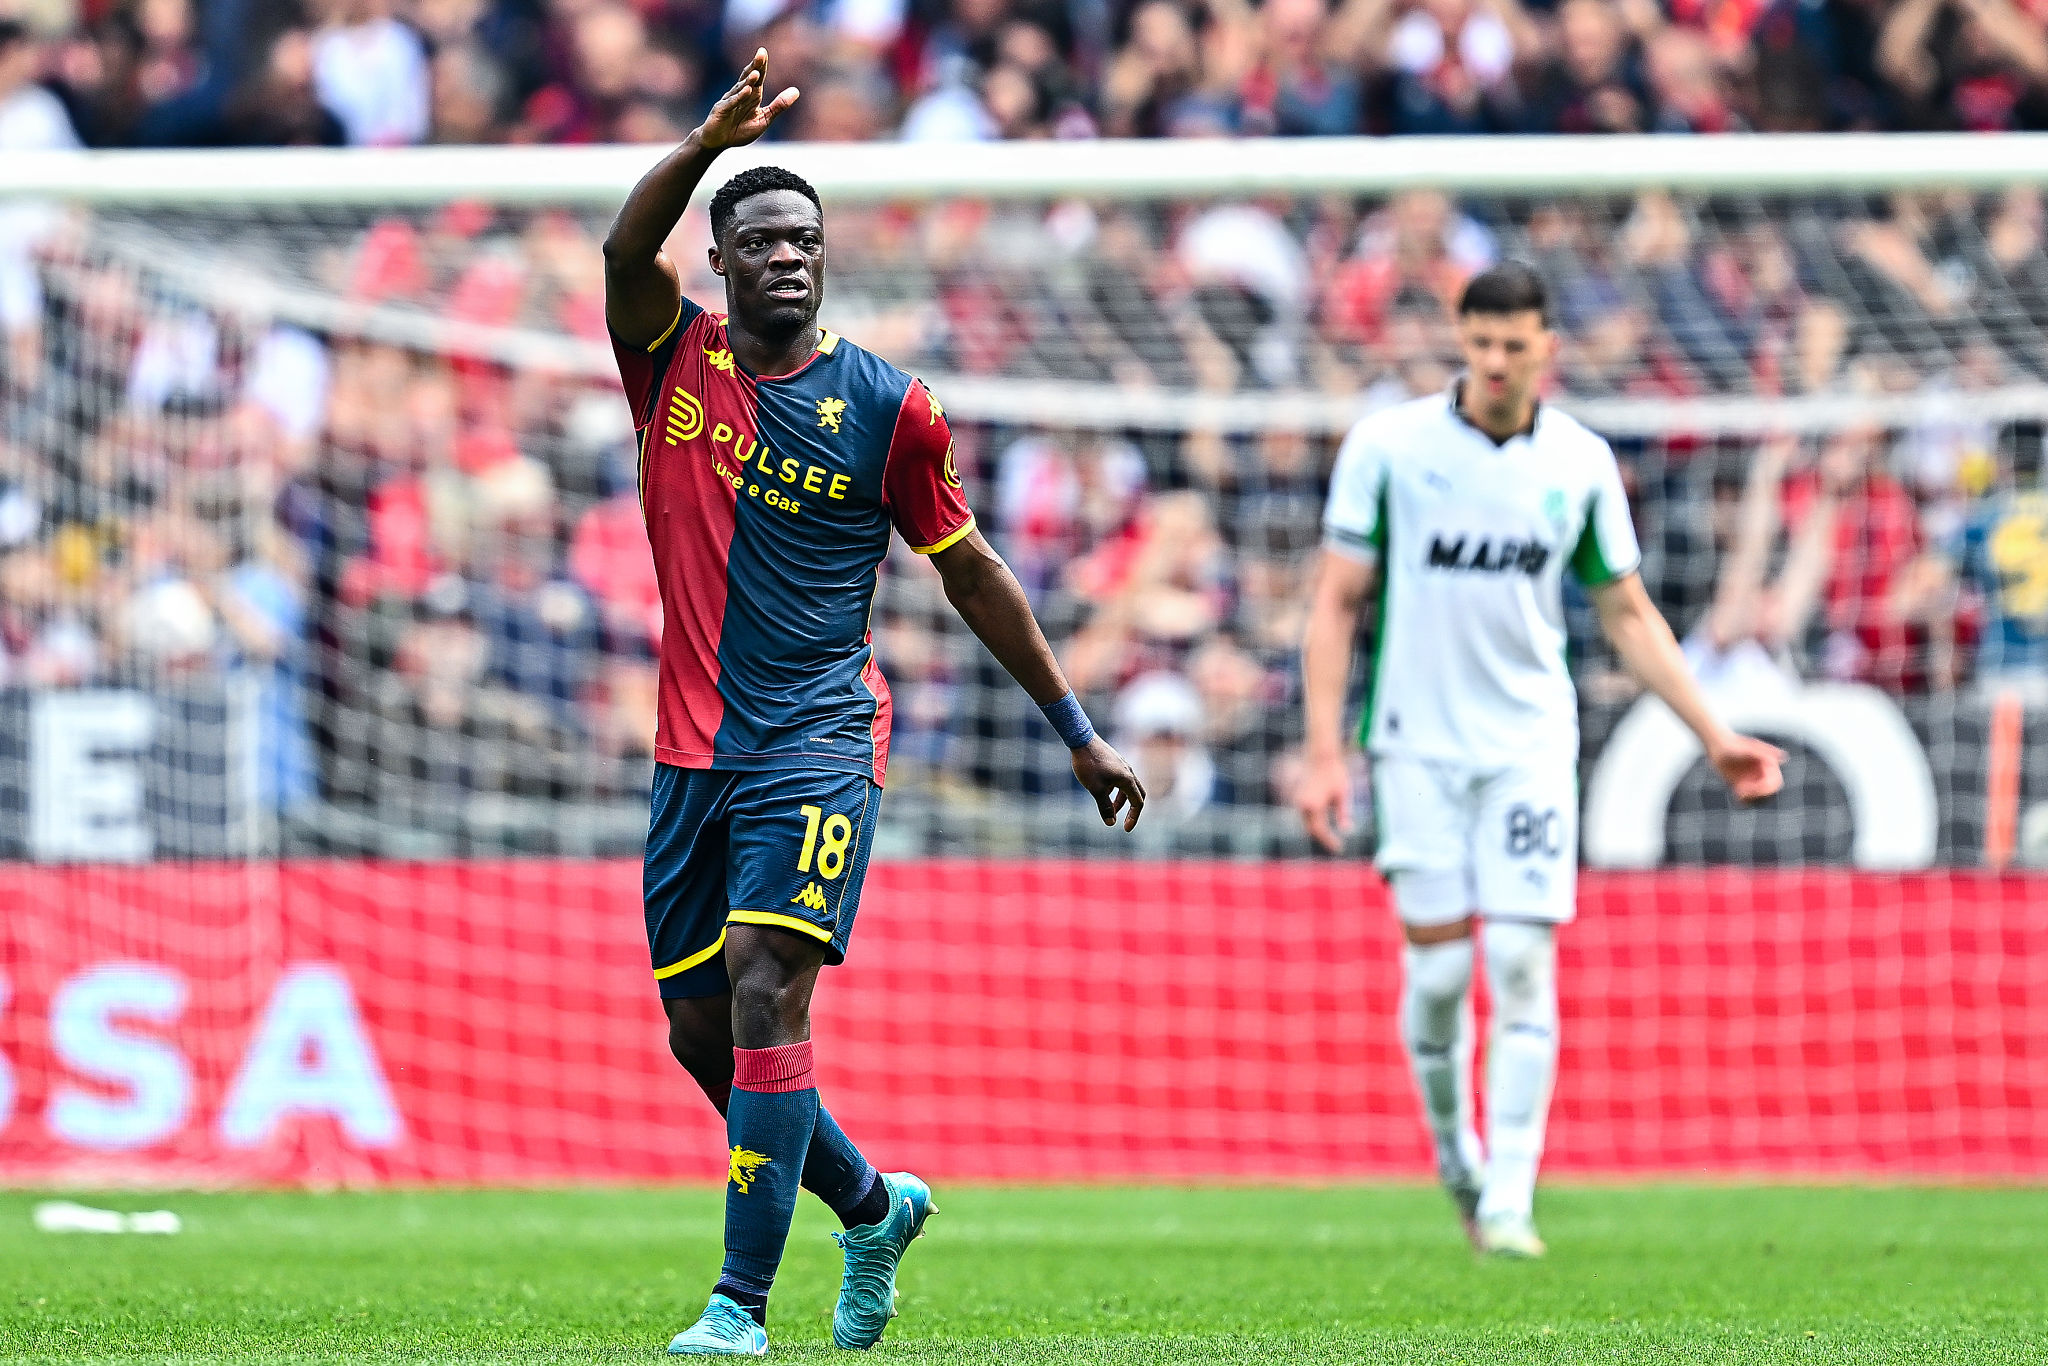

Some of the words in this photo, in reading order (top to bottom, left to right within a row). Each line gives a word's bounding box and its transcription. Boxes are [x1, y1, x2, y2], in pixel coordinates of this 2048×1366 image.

[711, 422, 852, 500] PULSEE
[748, 484, 760, 497] e
[764, 489, 801, 514] Gas
[796, 804, 852, 880] 18
[1505, 803, 1566, 860] 80
[0, 962, 404, 1148] SA
